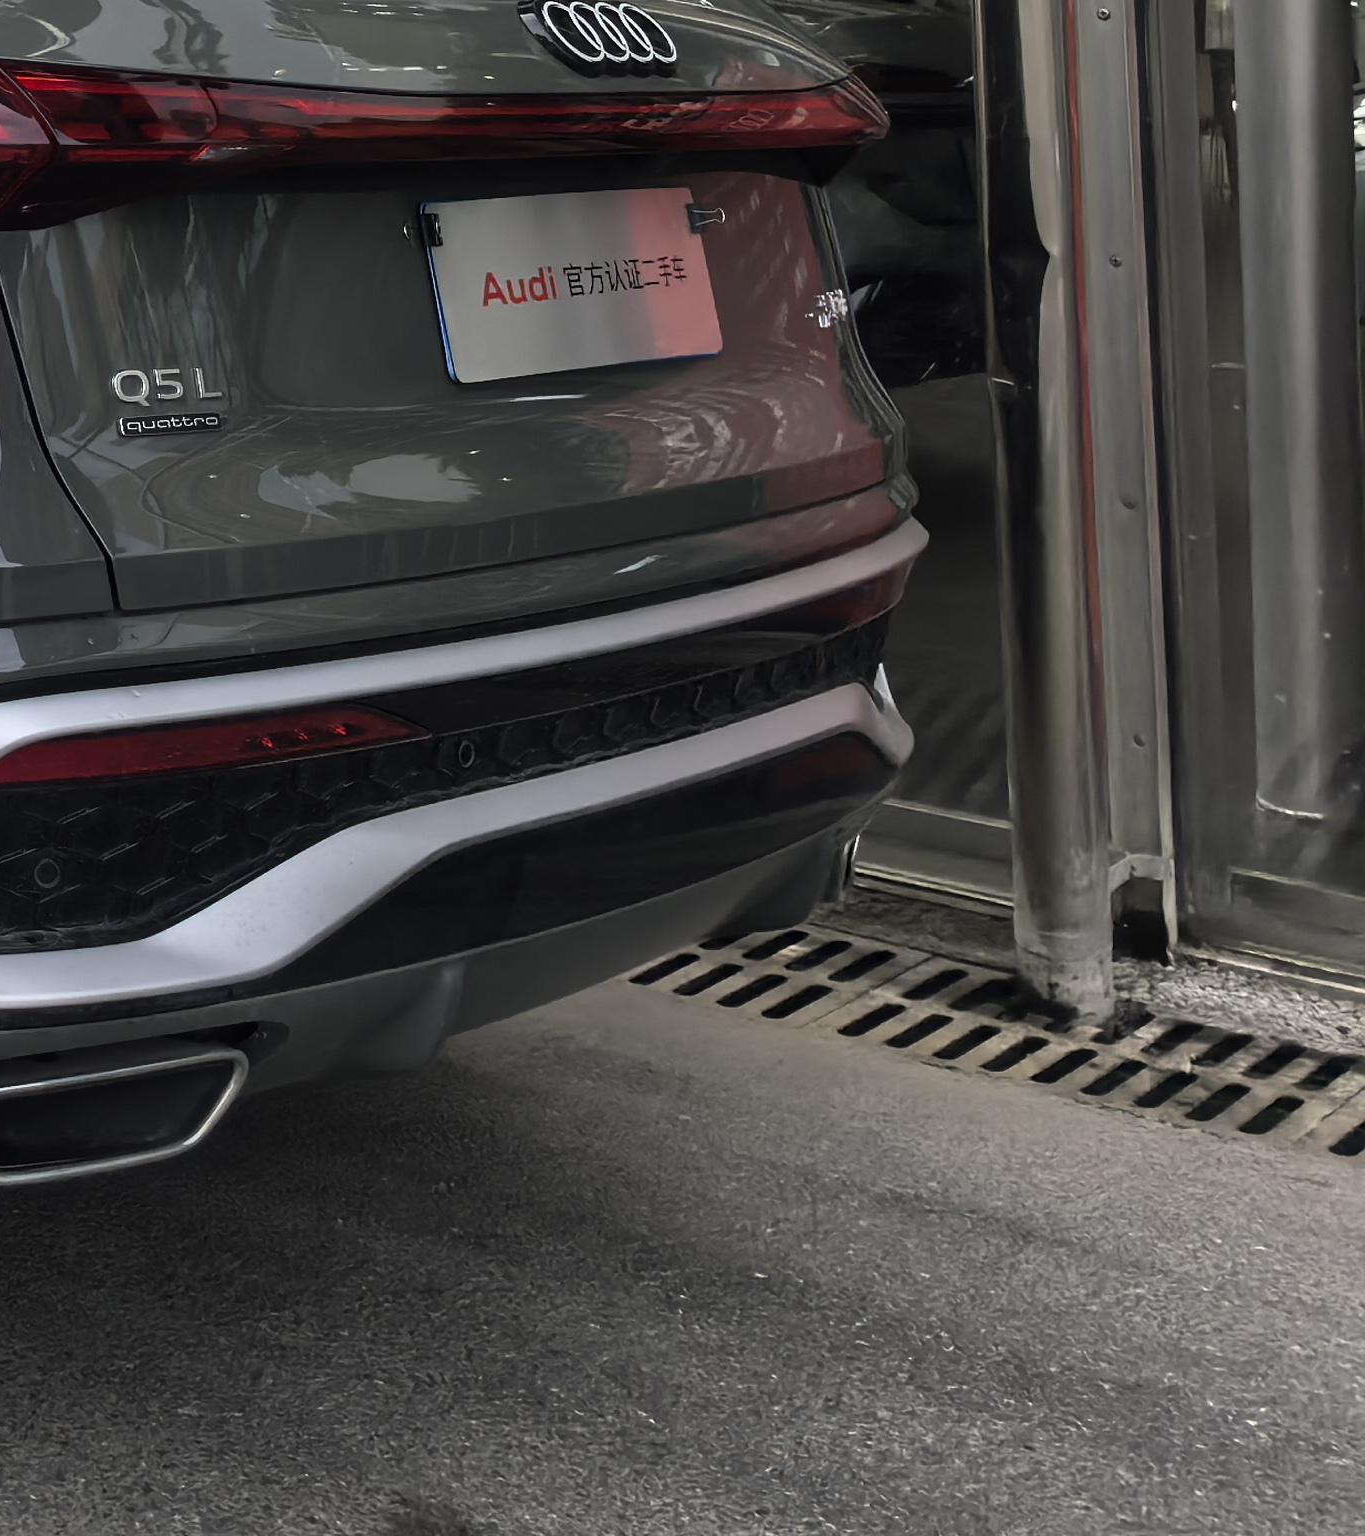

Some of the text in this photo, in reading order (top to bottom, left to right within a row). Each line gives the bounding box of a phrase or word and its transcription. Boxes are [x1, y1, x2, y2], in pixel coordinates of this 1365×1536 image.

[483, 256, 687, 307] Audi 官方认证二手车
[126, 416, 219, 433] quattro
